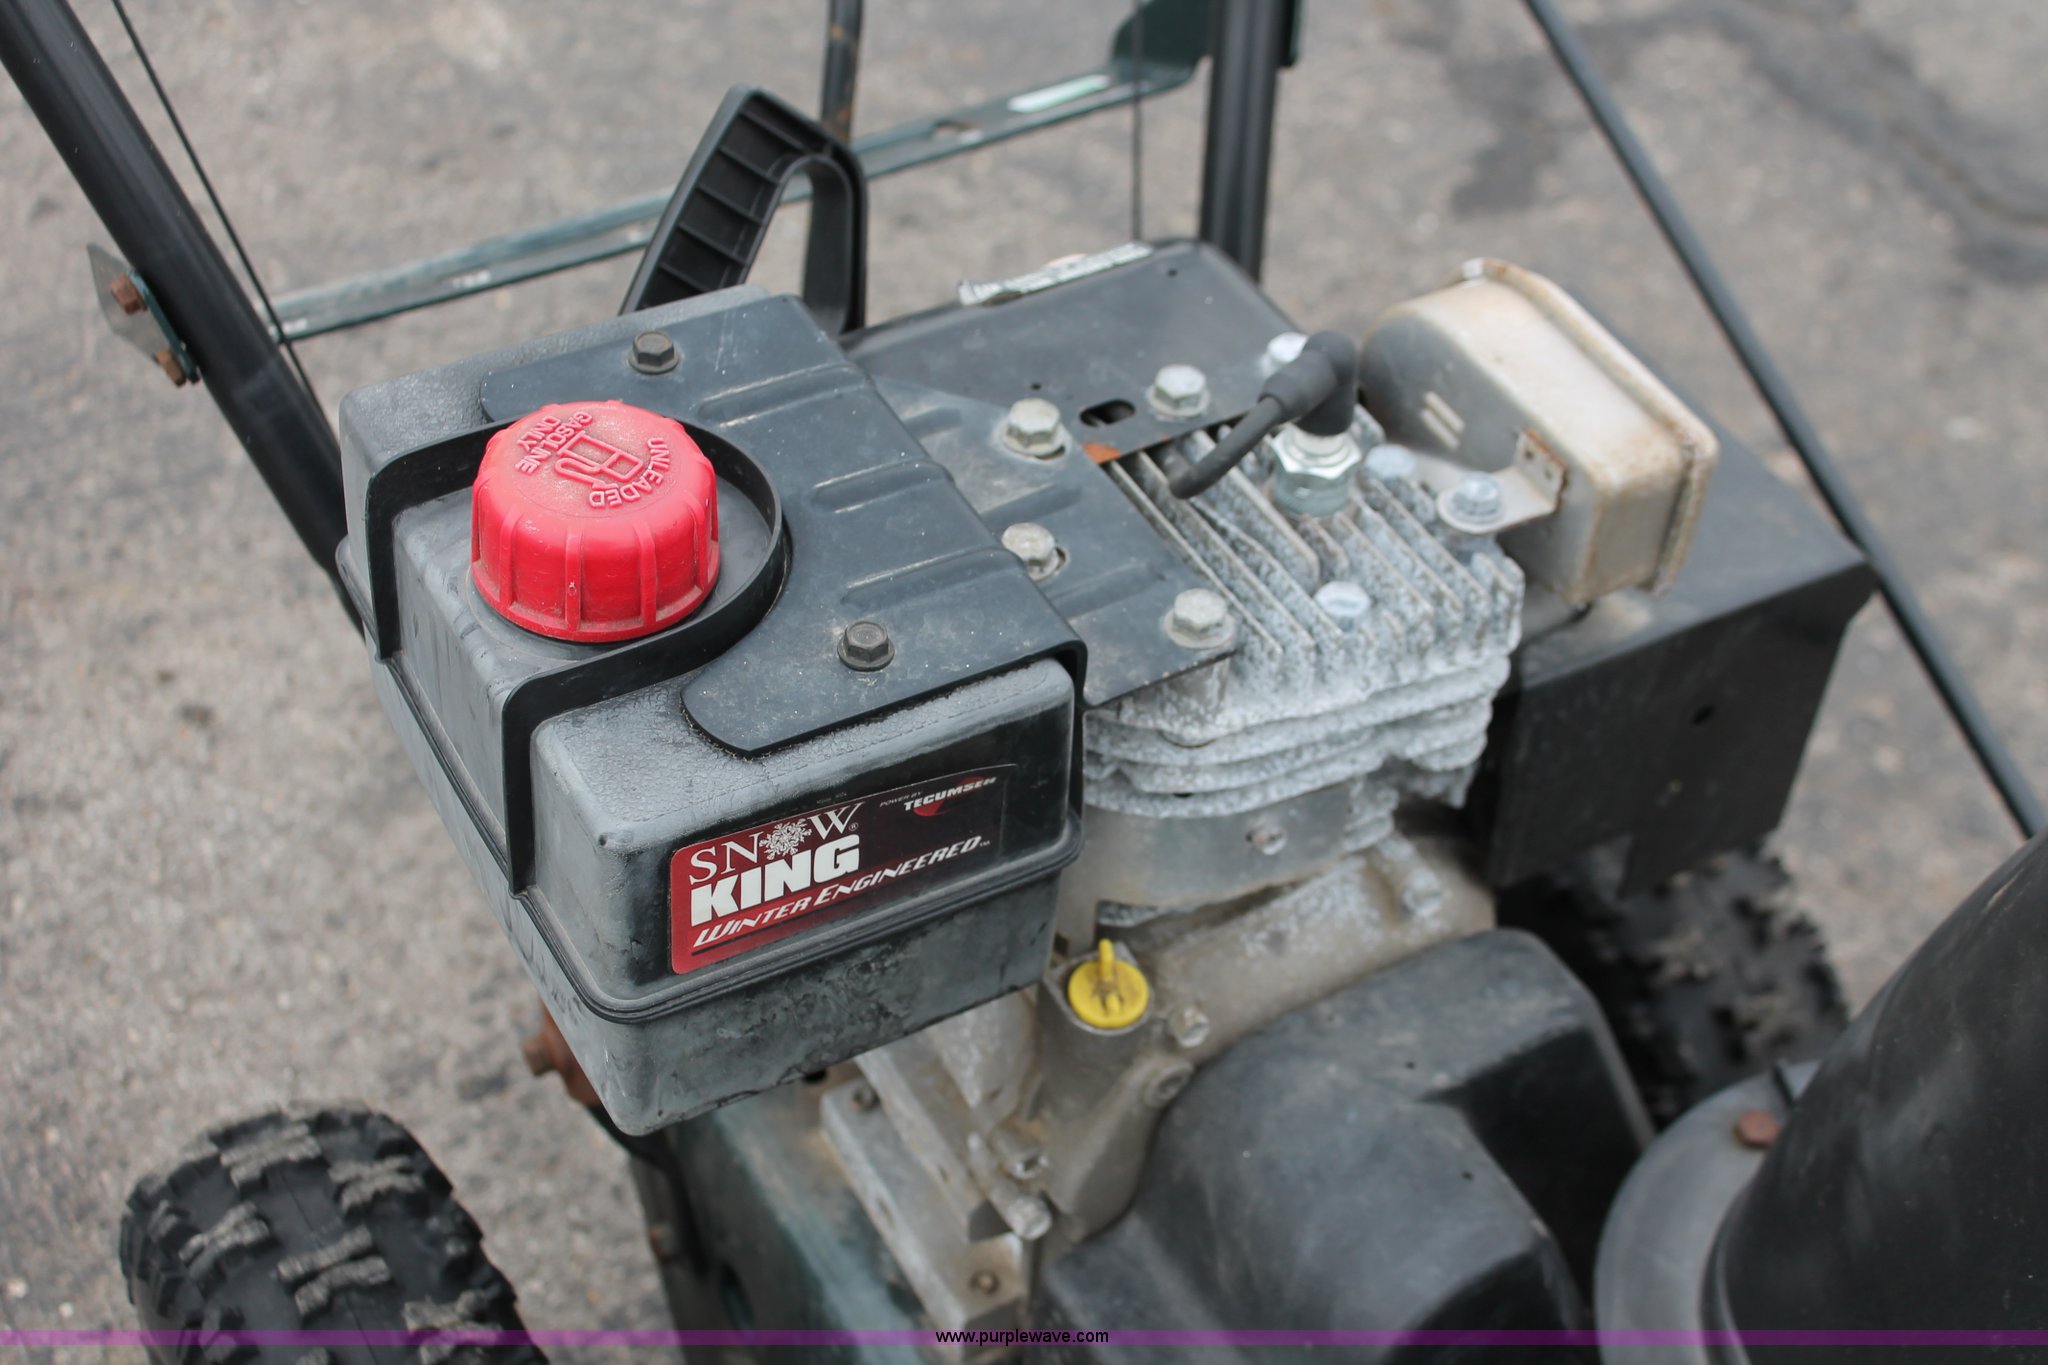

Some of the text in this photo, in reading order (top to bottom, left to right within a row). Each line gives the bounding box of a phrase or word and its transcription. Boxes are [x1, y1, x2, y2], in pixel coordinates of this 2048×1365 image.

[514, 411, 592, 475] GASOLINE
[517, 415, 561, 452] ONLY
[589, 437, 672, 509] UNLEADED
[904, 777, 997, 811] TECUMSEH
[691, 834, 860, 927] KING
[693, 895, 812, 948] WINTER
